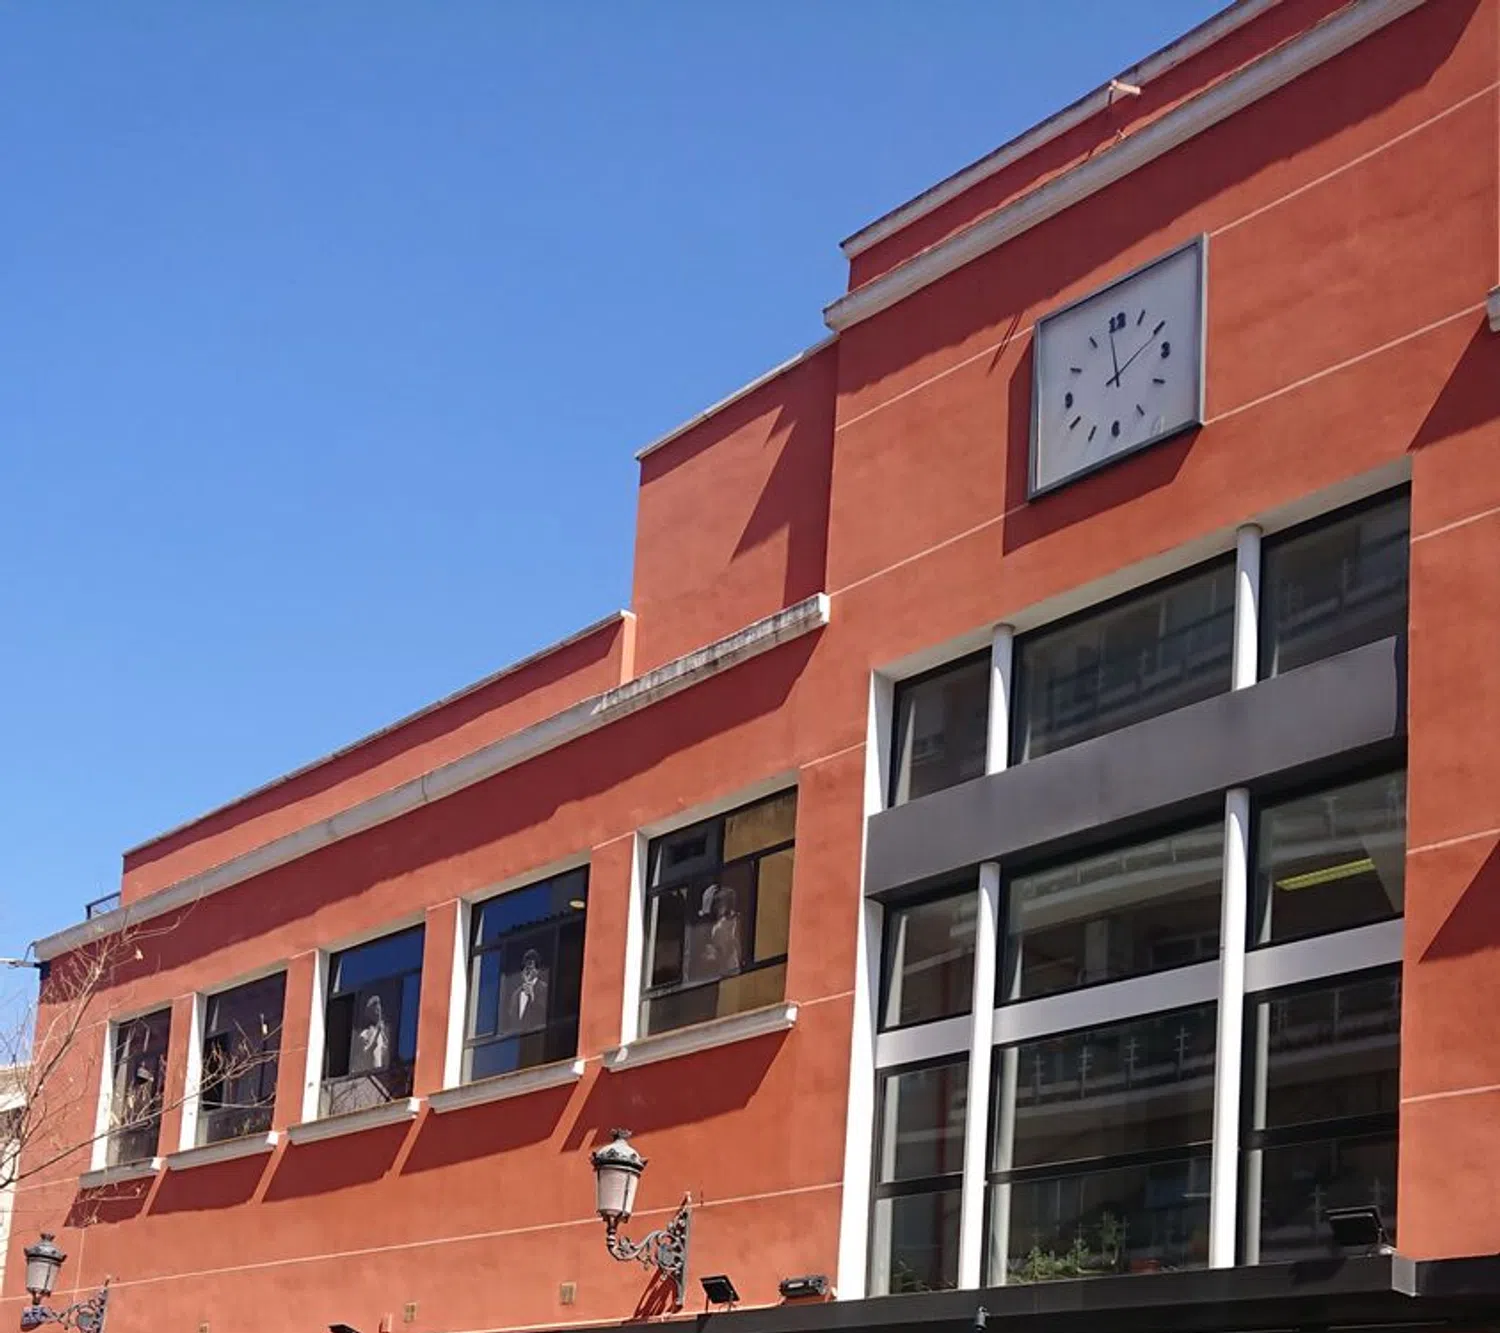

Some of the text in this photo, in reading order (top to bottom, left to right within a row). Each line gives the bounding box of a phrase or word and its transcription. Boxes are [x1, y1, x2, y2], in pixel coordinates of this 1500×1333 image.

[1109, 311, 1126, 333] 12
[1161, 341, 1171, 358] 3
[1064, 392, 1073, 409] 9
[1111, 420, 1120, 437] 6
